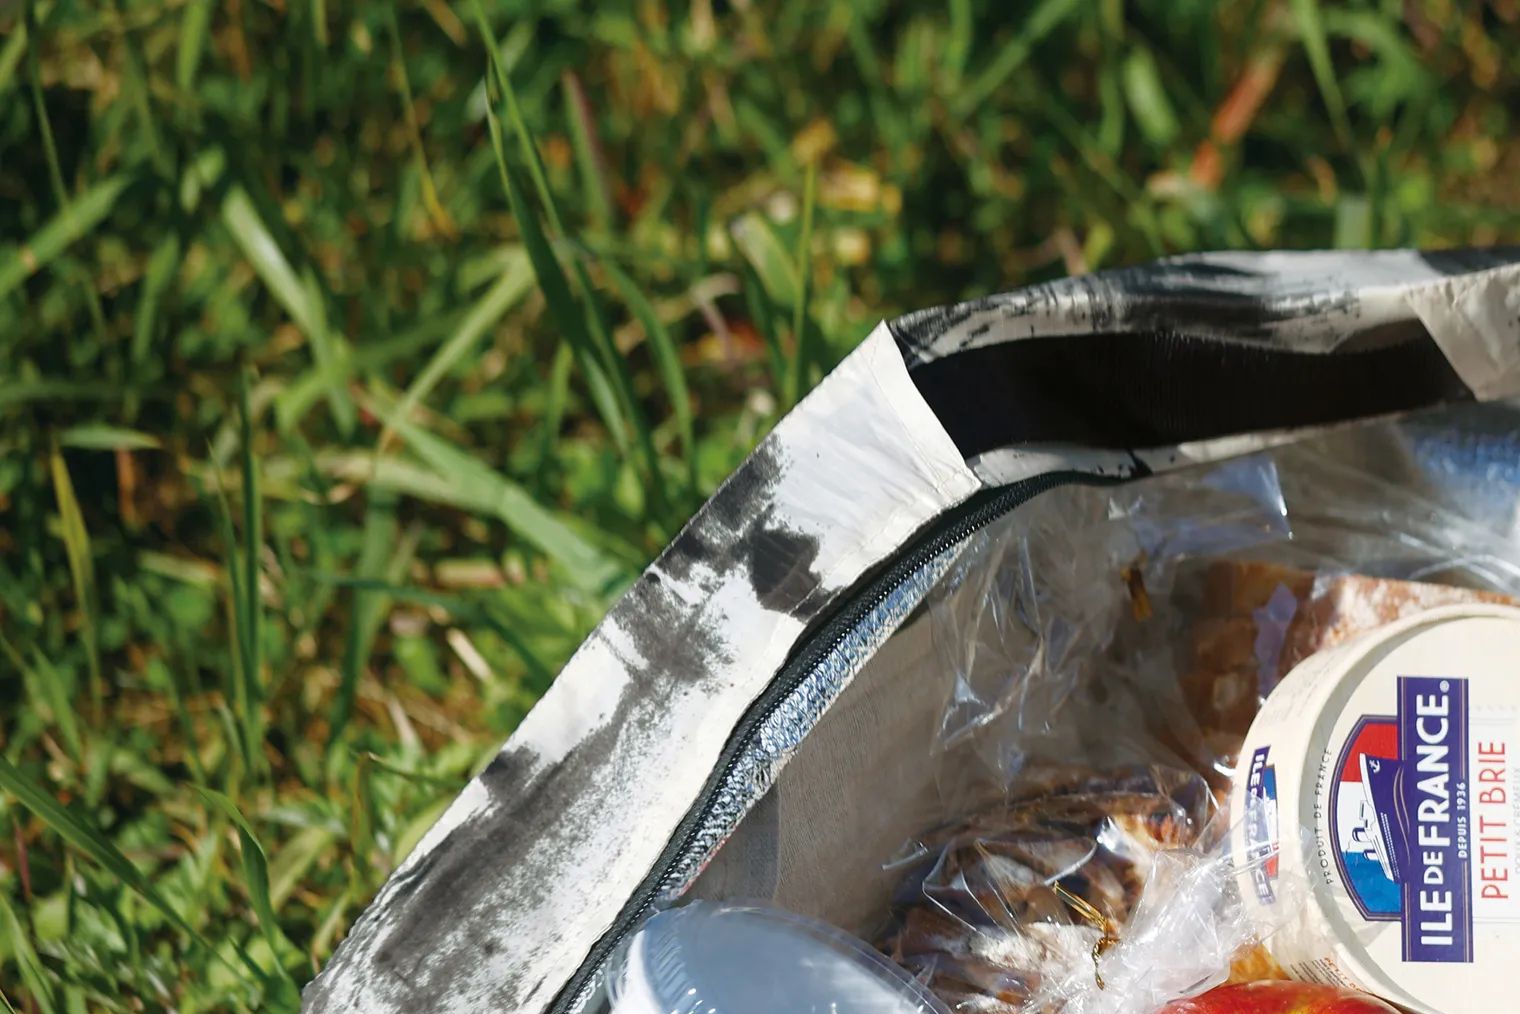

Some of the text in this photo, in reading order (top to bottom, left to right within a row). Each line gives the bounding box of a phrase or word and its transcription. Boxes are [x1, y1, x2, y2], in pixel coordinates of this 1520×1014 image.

[1249, 752, 1267, 787] ILE
[1313, 748, 1335, 886] PRODUIT DE FRANCE
[1456, 782, 1468, 859] DEPUIS 1936
[1477, 742, 1508, 900] PETIT BRIE
[1422, 851, 1445, 885] DE
[1419, 890, 1453, 946] ILE
